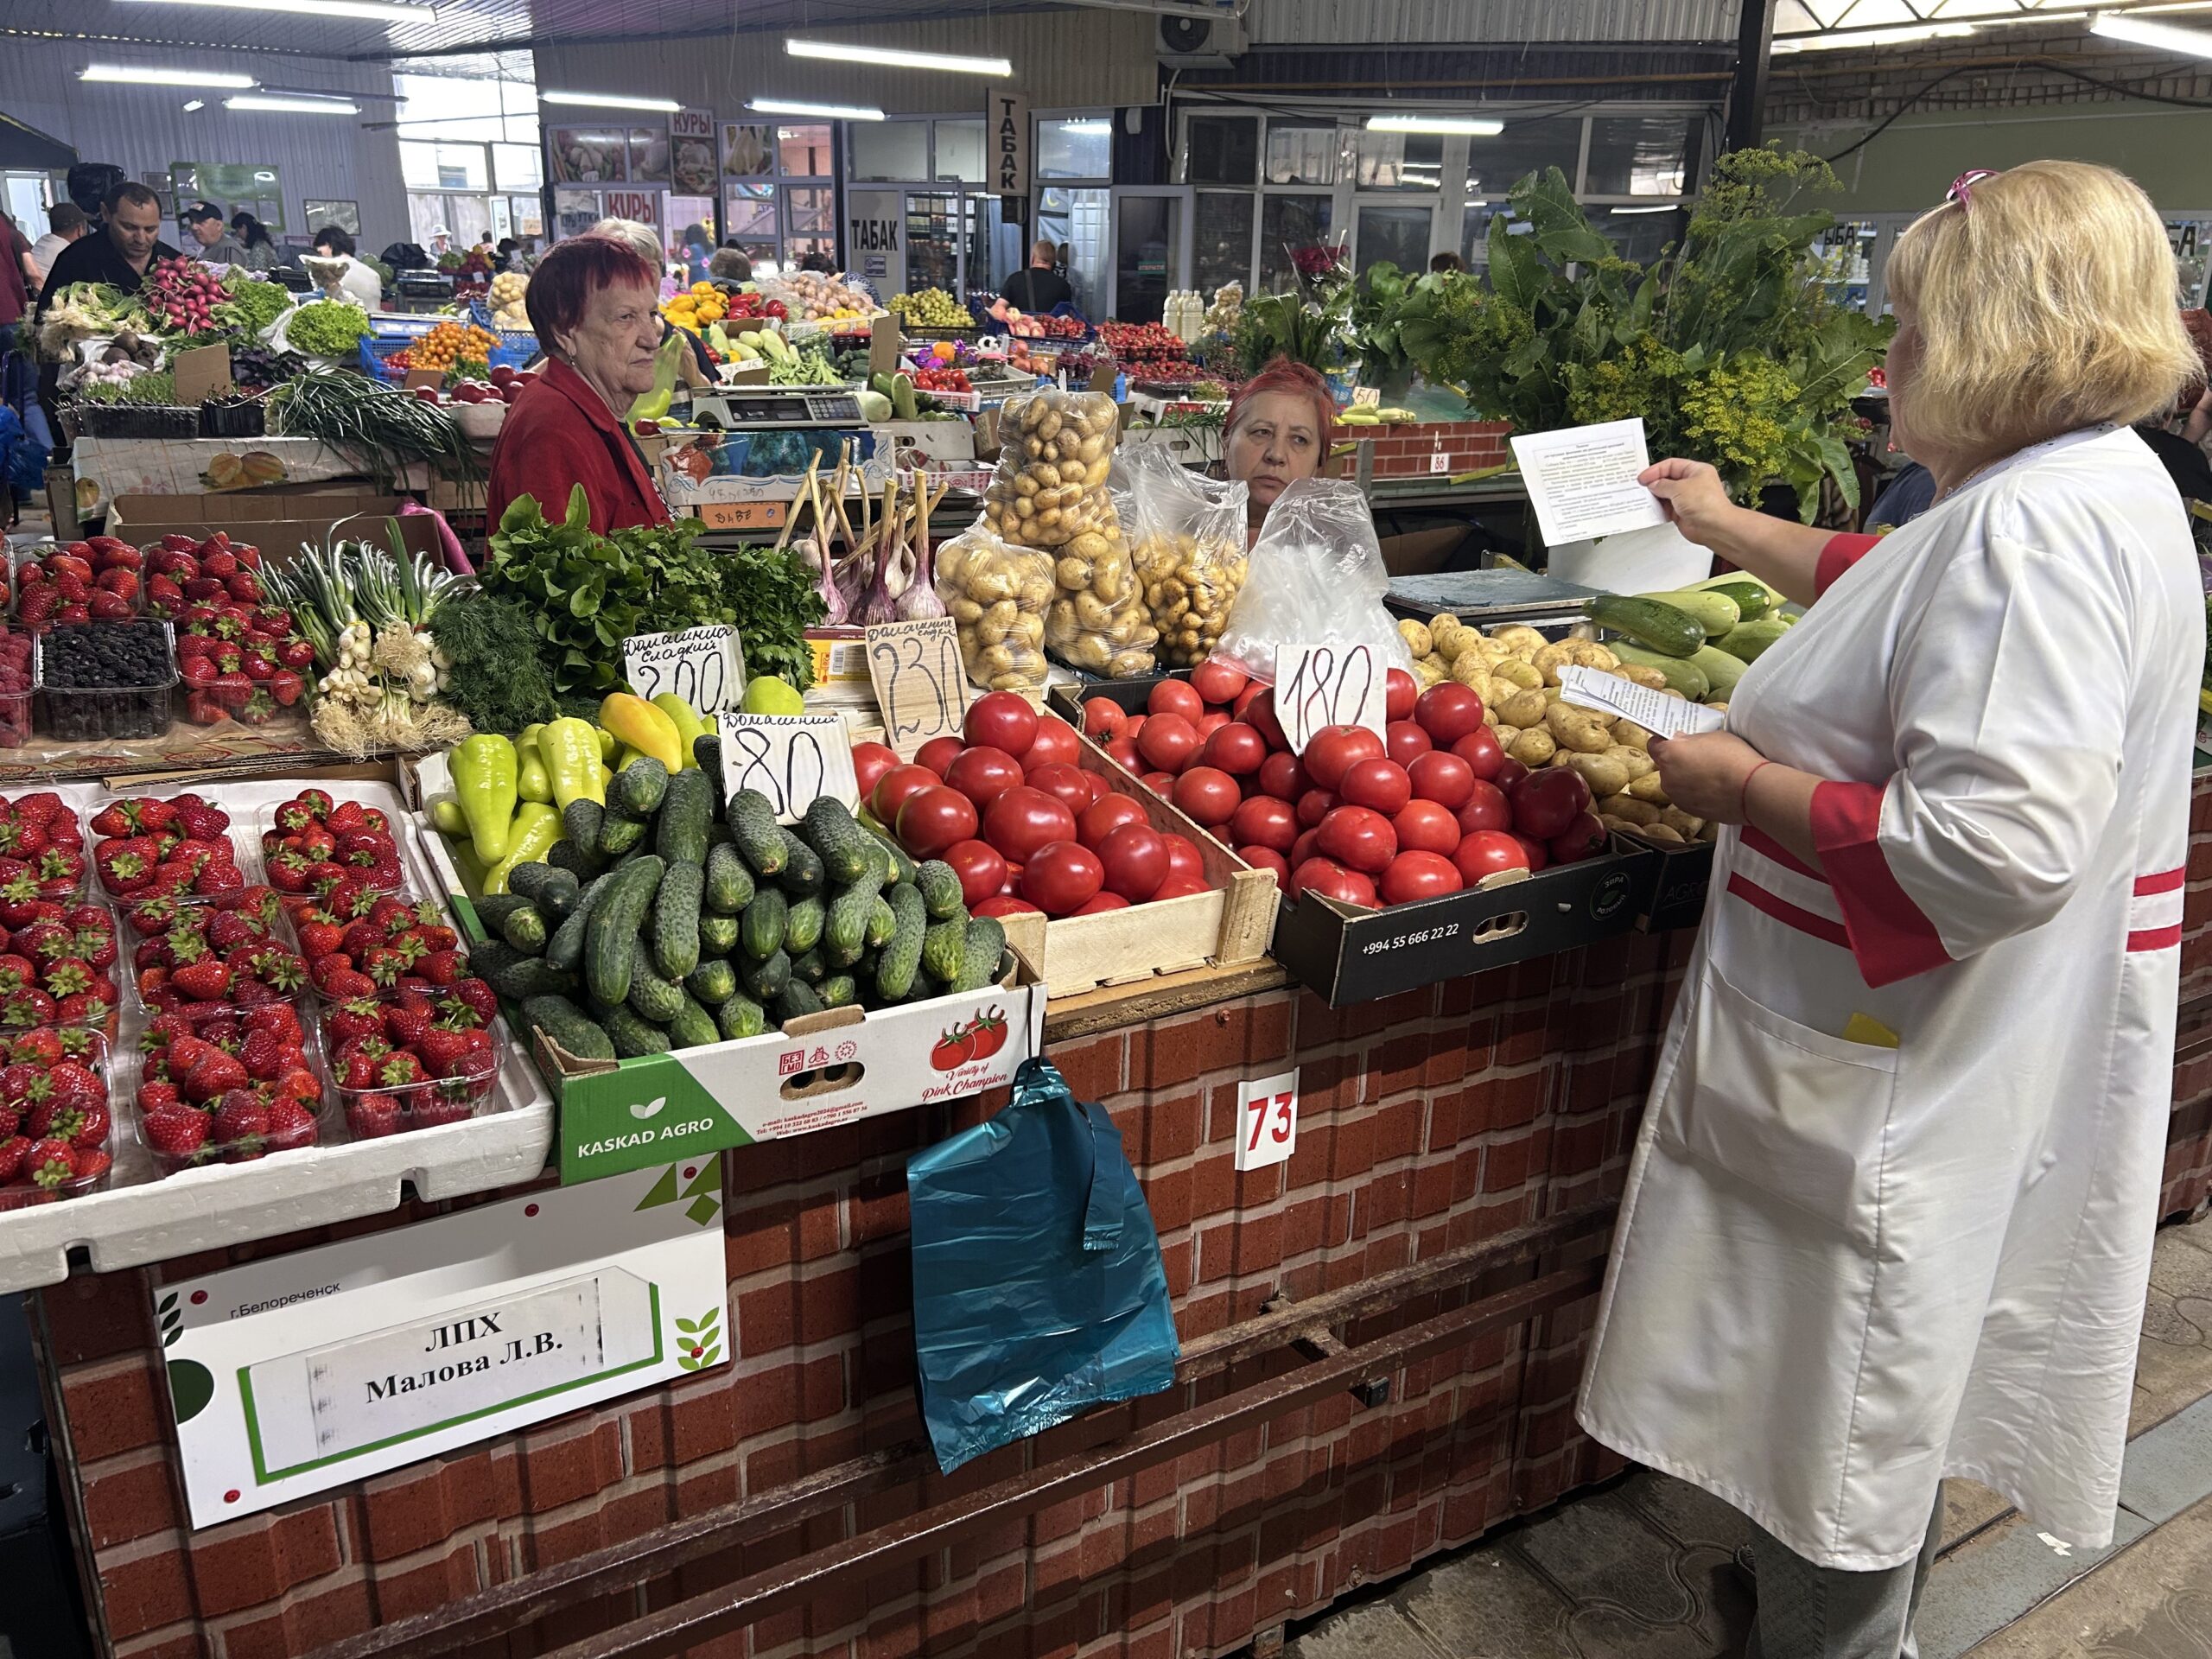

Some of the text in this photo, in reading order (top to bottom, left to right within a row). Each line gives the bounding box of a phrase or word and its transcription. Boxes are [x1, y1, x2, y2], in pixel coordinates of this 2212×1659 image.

[673, 111, 711, 135] КУРЫ
[1000, 98, 1017, 190] ТАБАК
[607, 193, 657, 223] КУРЫ
[850, 219, 899, 251] ТАБАК
[2165, 225, 2196, 257] БА
[1434, 455, 1445, 470] 86
[873, 636, 965, 744] 230
[1283, 645, 1372, 750] 180
[734, 727, 824, 822] 80
[1362, 923, 1459, 955] +994 55 666 22 22
[782, 1061, 801, 1073] ГМО
[783, 1052, 802, 1065] БЕЗ
[945, 1062, 989, 1081] Variety of
[921, 1073, 1008, 1102] Pink Champion
[1248, 1090, 1294, 1152] 73
[577, 1117, 715, 1159] KASKAD AGRO
[230, 1282, 341, 1319] г.Белореченск
[424, 1311, 504, 1352] ЛПХ
[364, 1331, 563, 1404] Малова Л.В.
